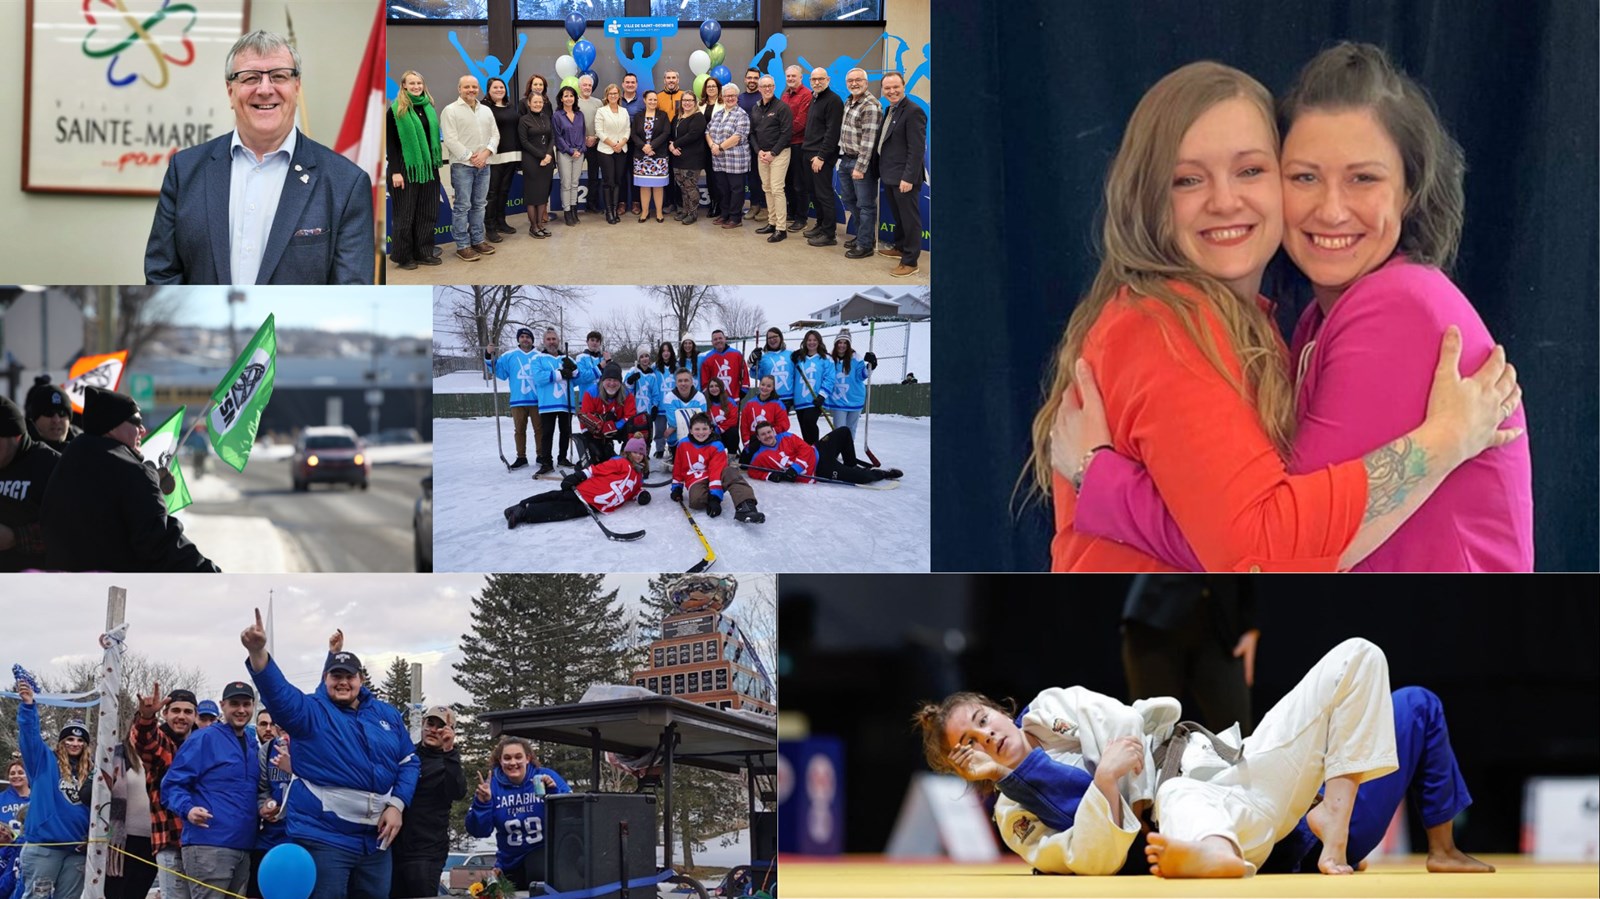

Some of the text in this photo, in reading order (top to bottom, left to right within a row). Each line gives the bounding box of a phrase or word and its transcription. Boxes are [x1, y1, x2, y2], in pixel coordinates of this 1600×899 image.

[55, 115, 213, 148] SAINTE-MARIE
[577, 185, 588, 203] 2
[496, 793, 544, 808] CARABIN
[504, 817, 543, 846] 69
